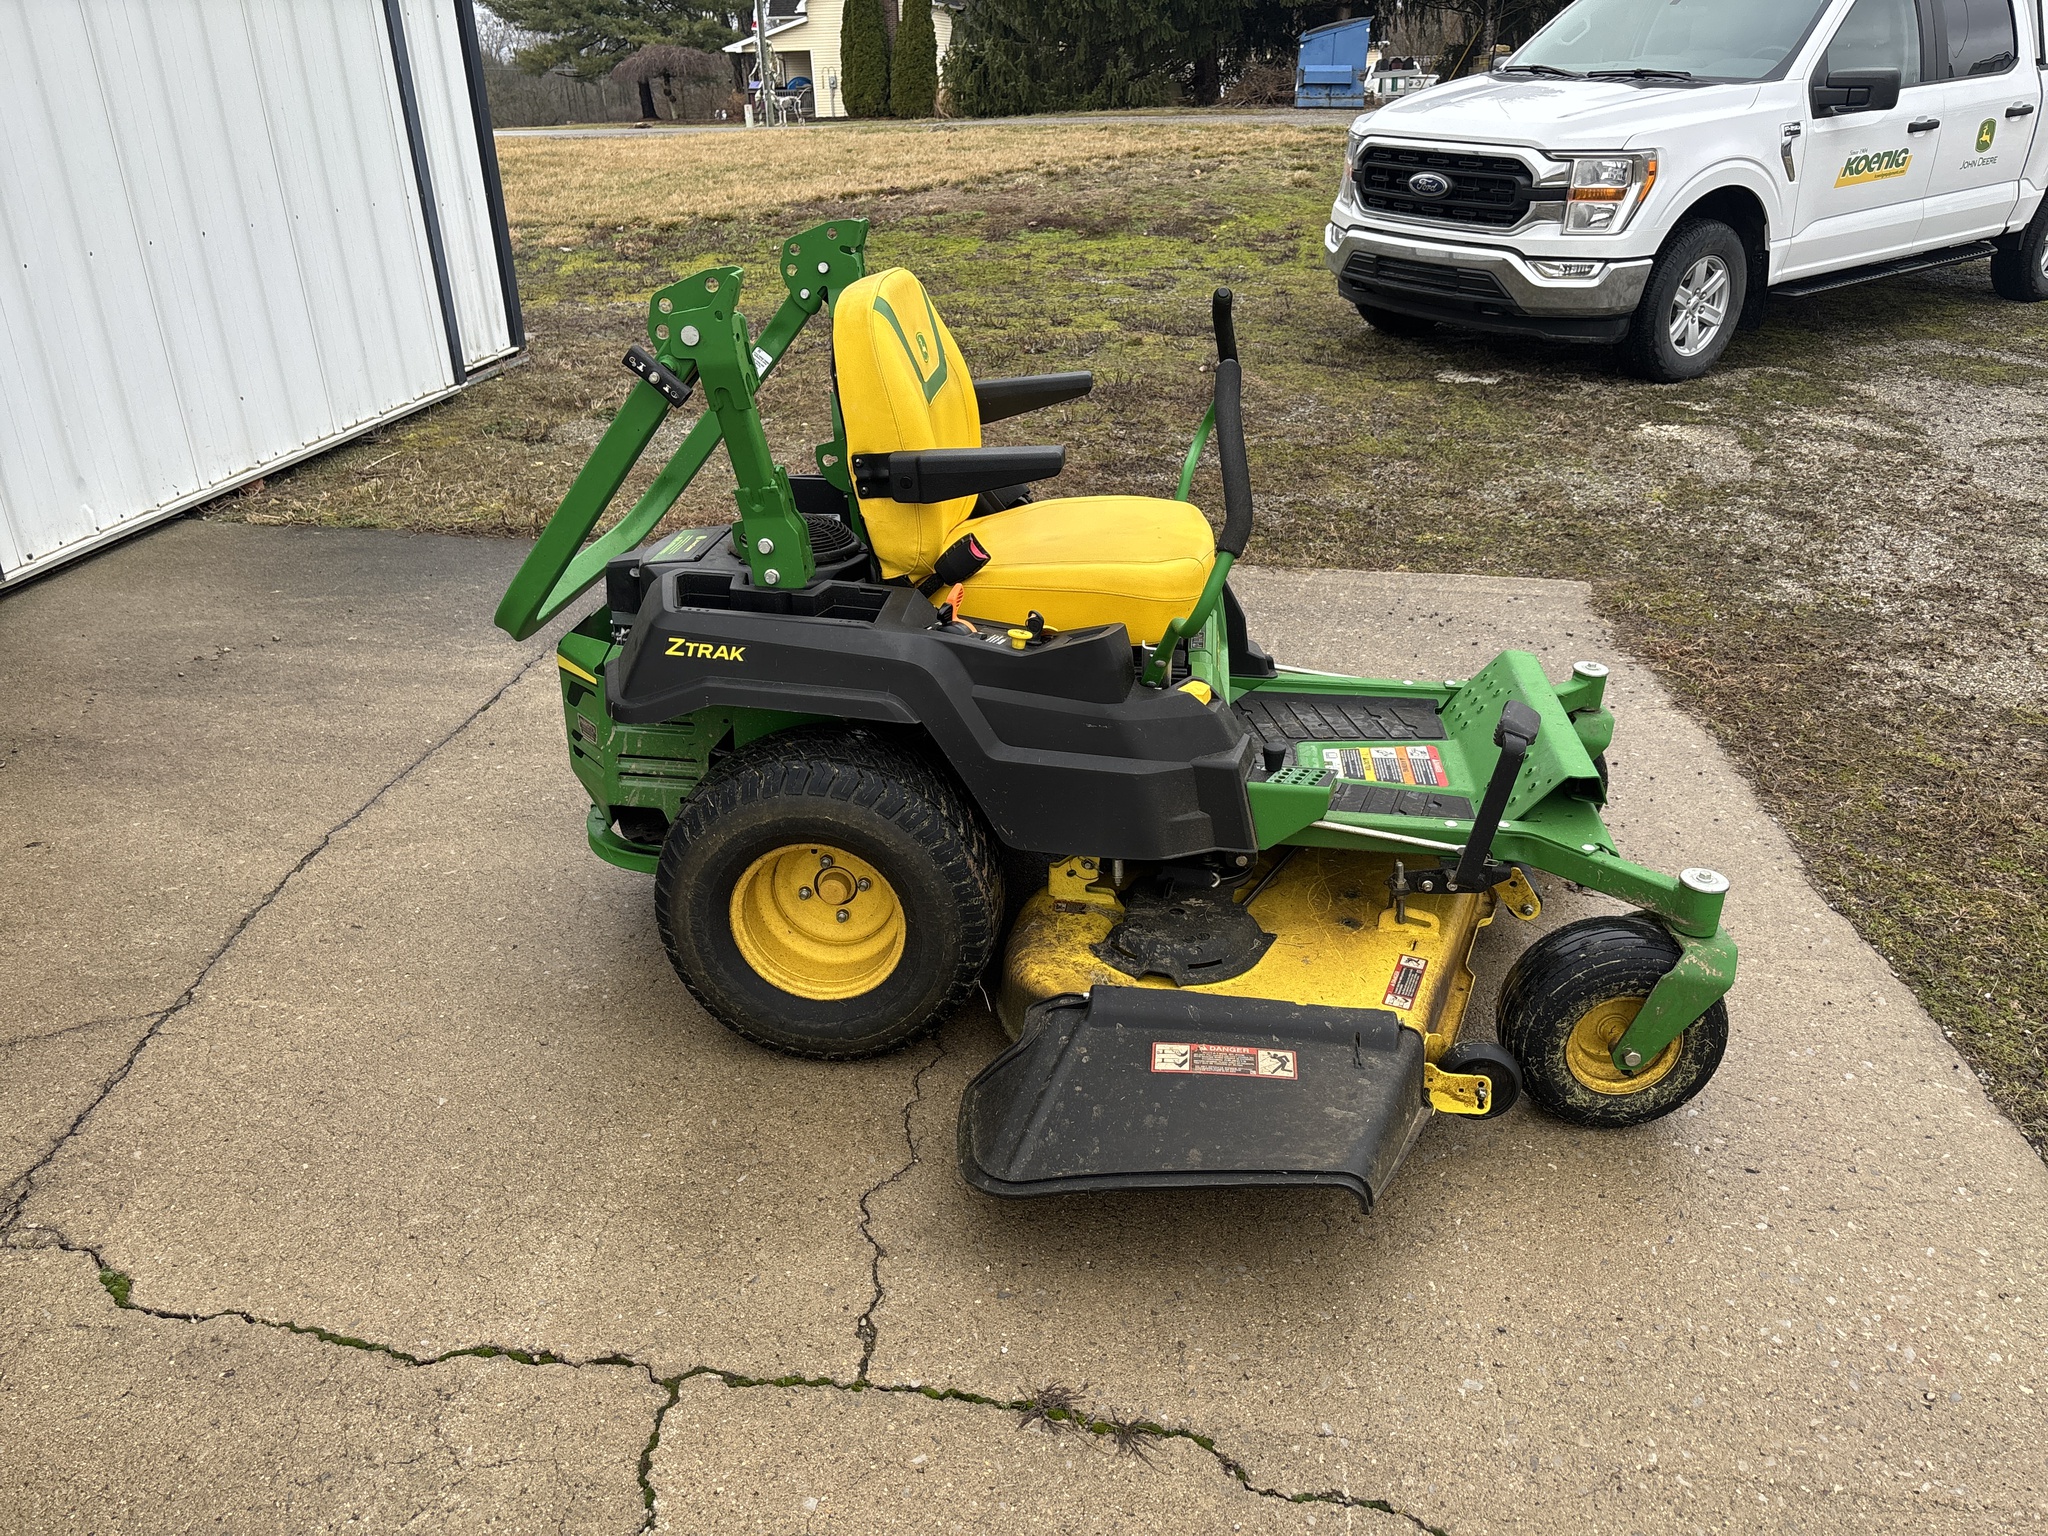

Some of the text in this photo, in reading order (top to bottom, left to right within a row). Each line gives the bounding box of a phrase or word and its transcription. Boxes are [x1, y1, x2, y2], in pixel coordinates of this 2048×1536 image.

[1959, 156, 1998, 170] JOHN DEERE
[1416, 178, 1437, 191] Ford
[665, 637, 746, 661] ZTRAK
[1209, 1045, 1250, 1054] DANGER
